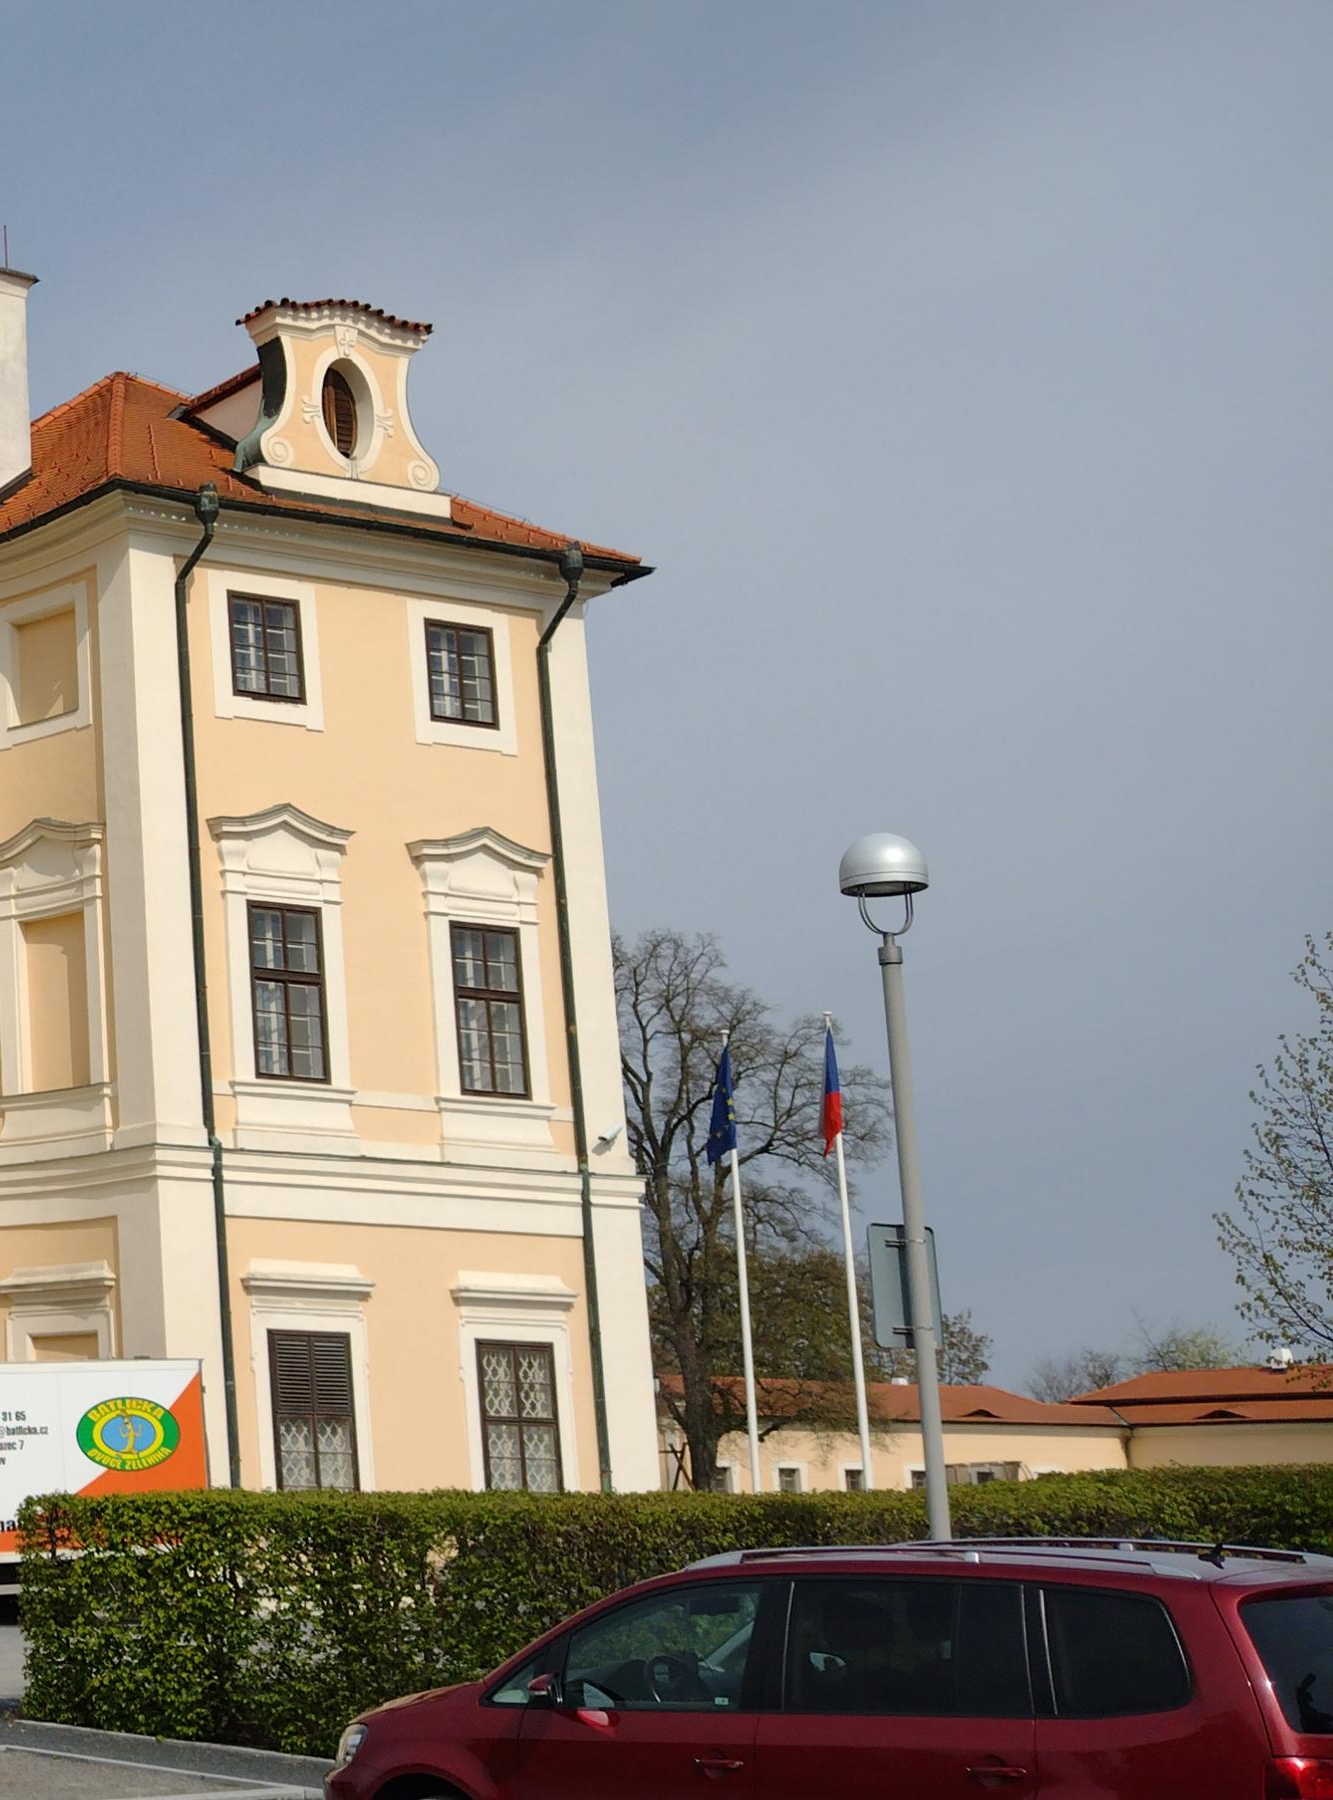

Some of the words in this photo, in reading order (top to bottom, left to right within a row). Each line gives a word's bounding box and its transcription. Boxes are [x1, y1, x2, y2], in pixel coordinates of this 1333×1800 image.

[87, 1399, 165, 1421] BATLICKA
[2, 1411, 12, 1421] 31
[19, 1440, 24, 1450] 7
